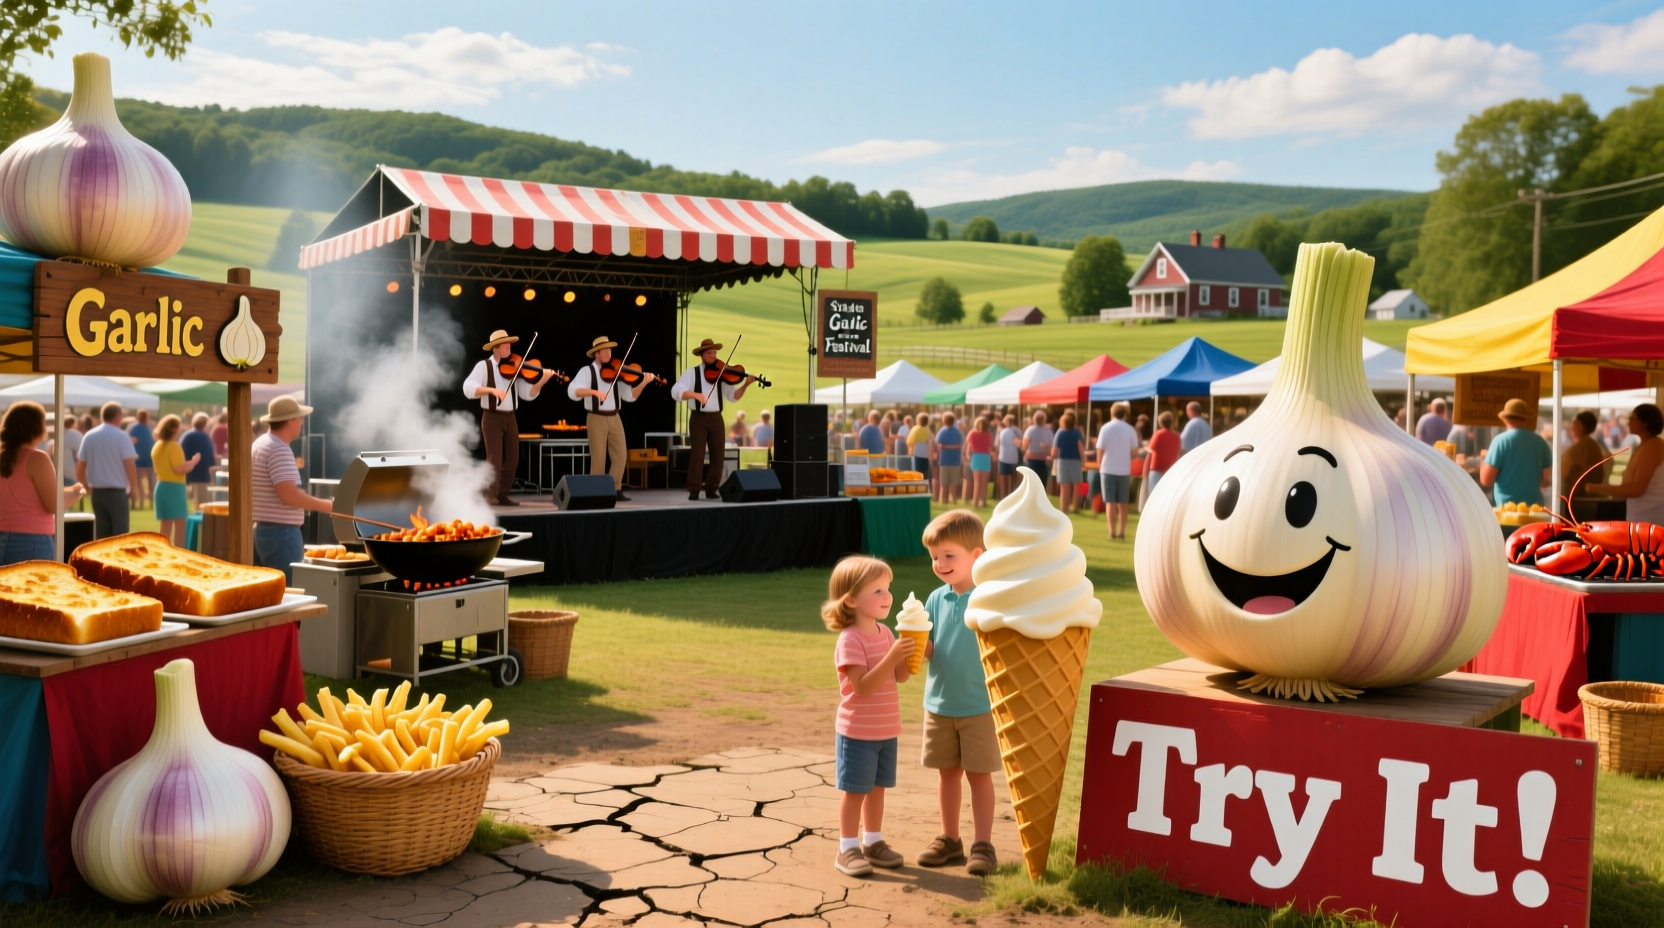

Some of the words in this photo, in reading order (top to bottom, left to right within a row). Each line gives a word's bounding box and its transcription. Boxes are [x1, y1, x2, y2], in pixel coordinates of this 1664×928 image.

[65, 287, 205, 358] Garlic
[1112, 719, 1342, 889] Try
[1371, 757, 1557, 908] It!
